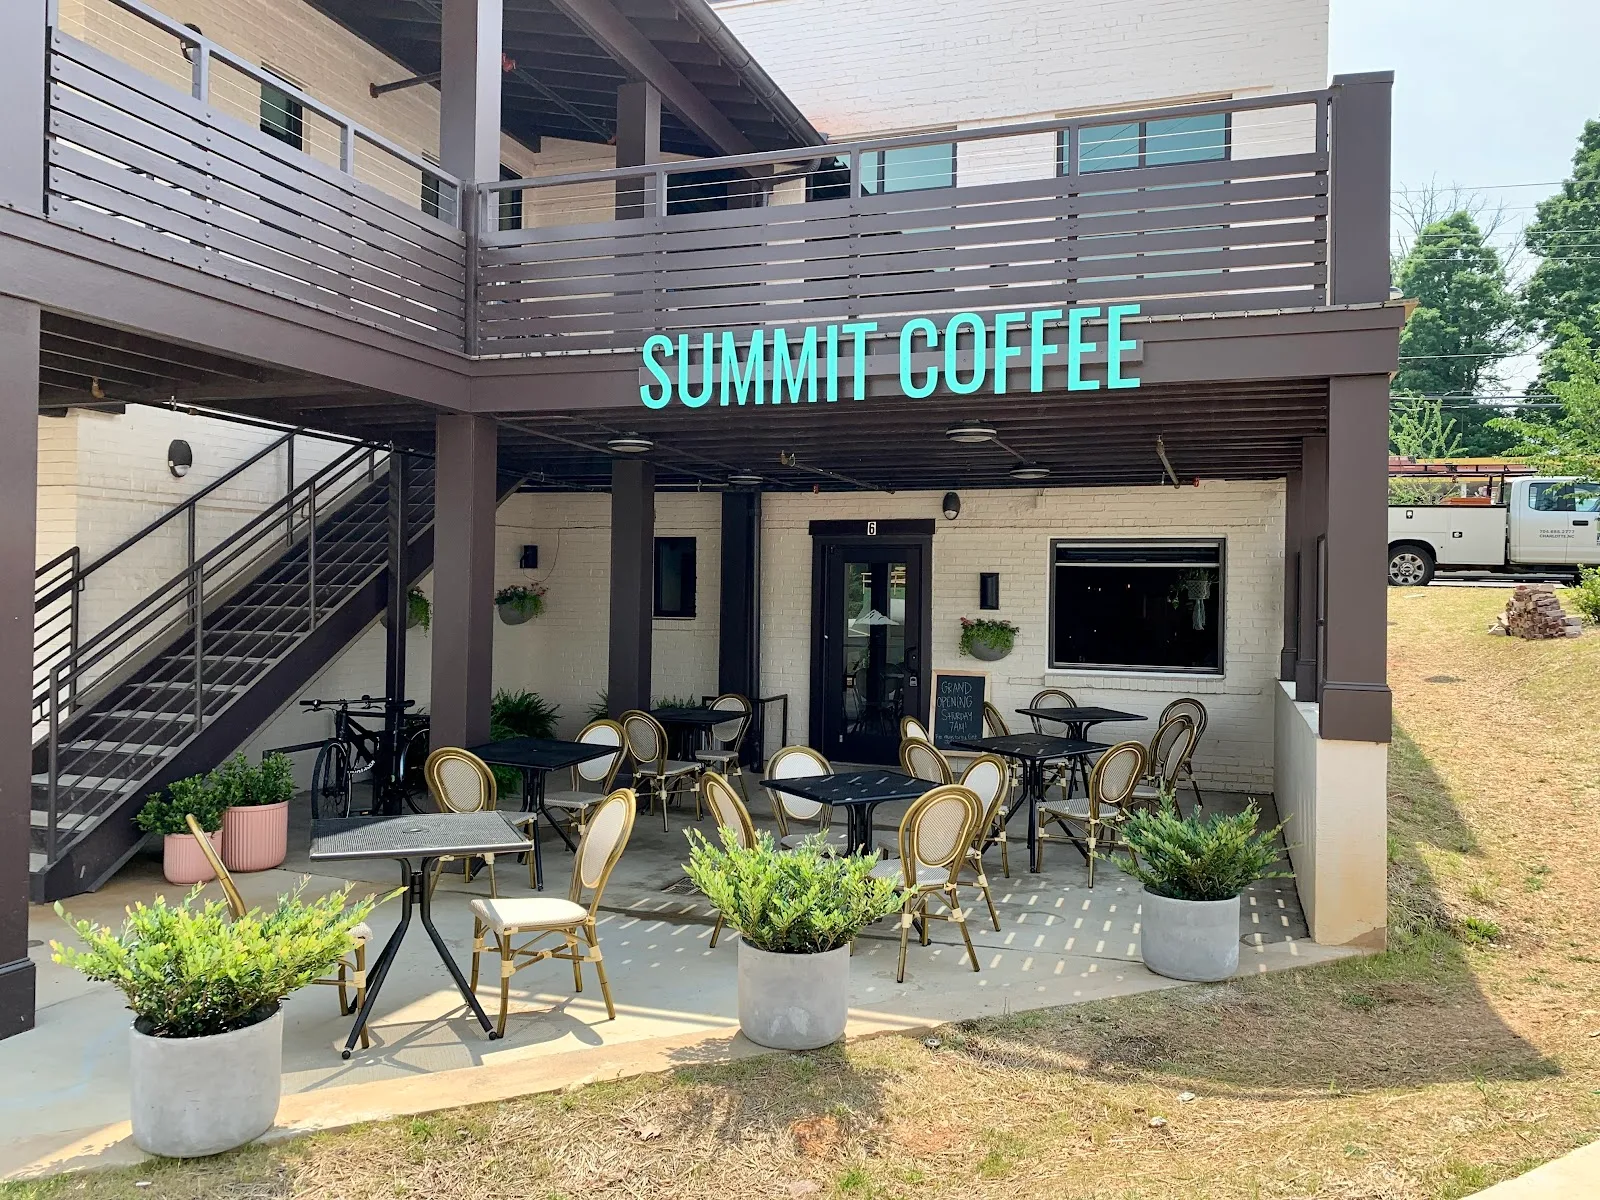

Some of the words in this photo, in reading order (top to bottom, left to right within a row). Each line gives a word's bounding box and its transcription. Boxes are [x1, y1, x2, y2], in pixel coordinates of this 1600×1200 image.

[639, 321, 878, 410] SUMMIT
[899, 303, 1142, 400] COFFEE
[868, 522, 875, 535] 6
[941, 680, 972, 695] GRAND
[936, 695, 973, 708] OPENING
